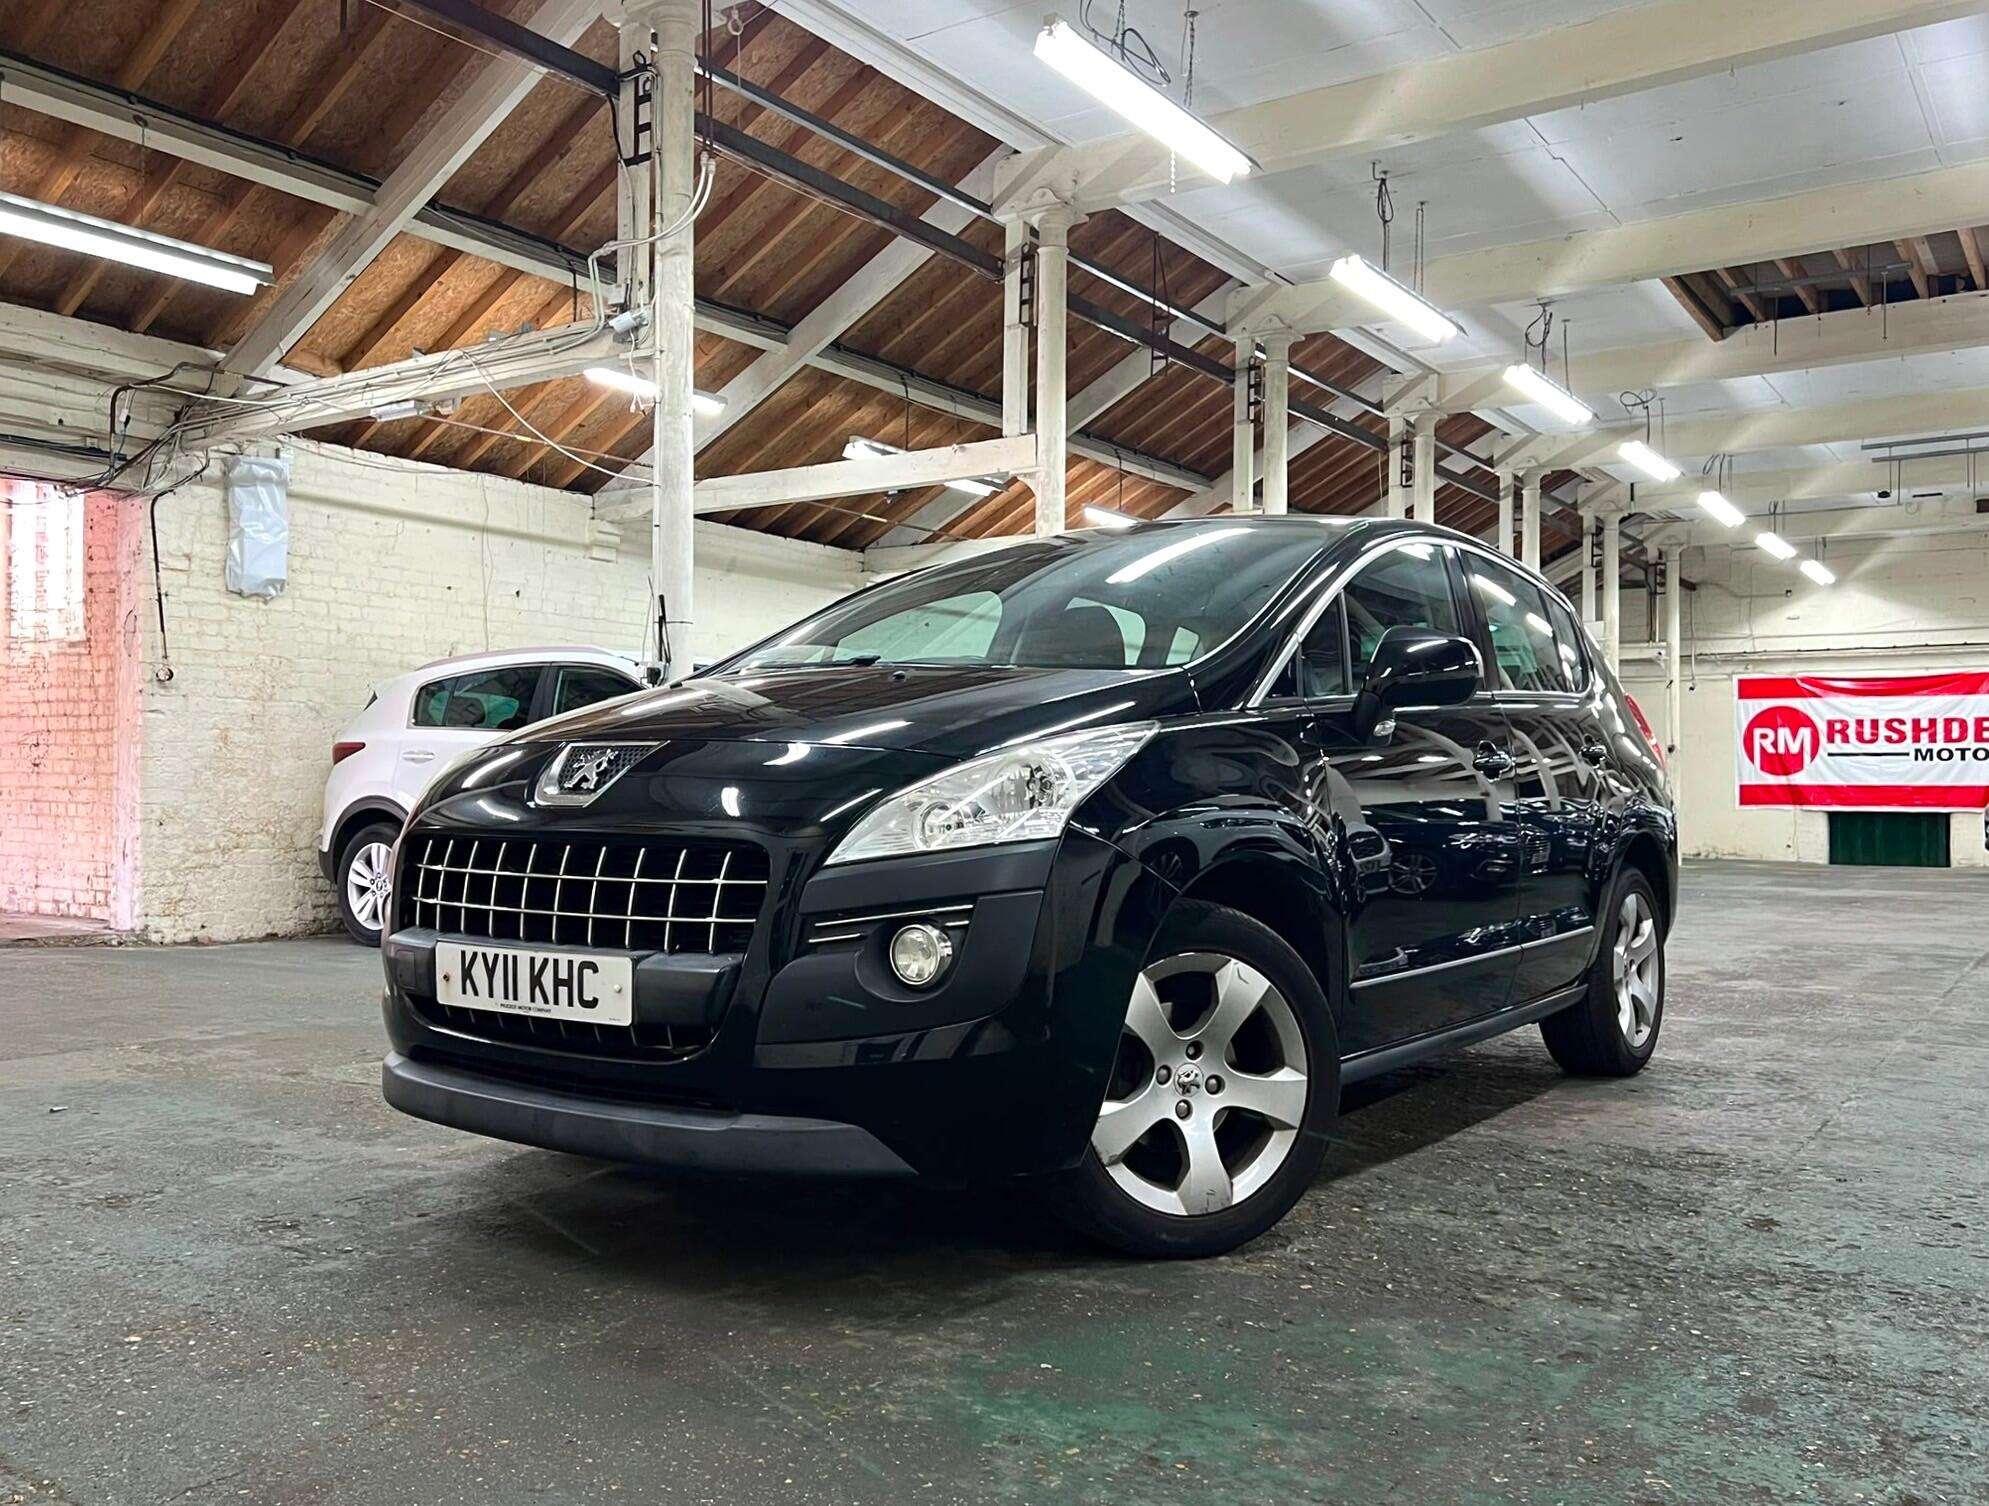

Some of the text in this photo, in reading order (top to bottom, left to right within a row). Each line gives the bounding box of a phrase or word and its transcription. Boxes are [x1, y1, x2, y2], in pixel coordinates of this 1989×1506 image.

[1752, 726, 1812, 768] RM
[1826, 717, 1989, 744] RUSHDE
[1914, 748, 1989, 762] MOTO
[461, 950, 599, 1010] KY11 KHC
